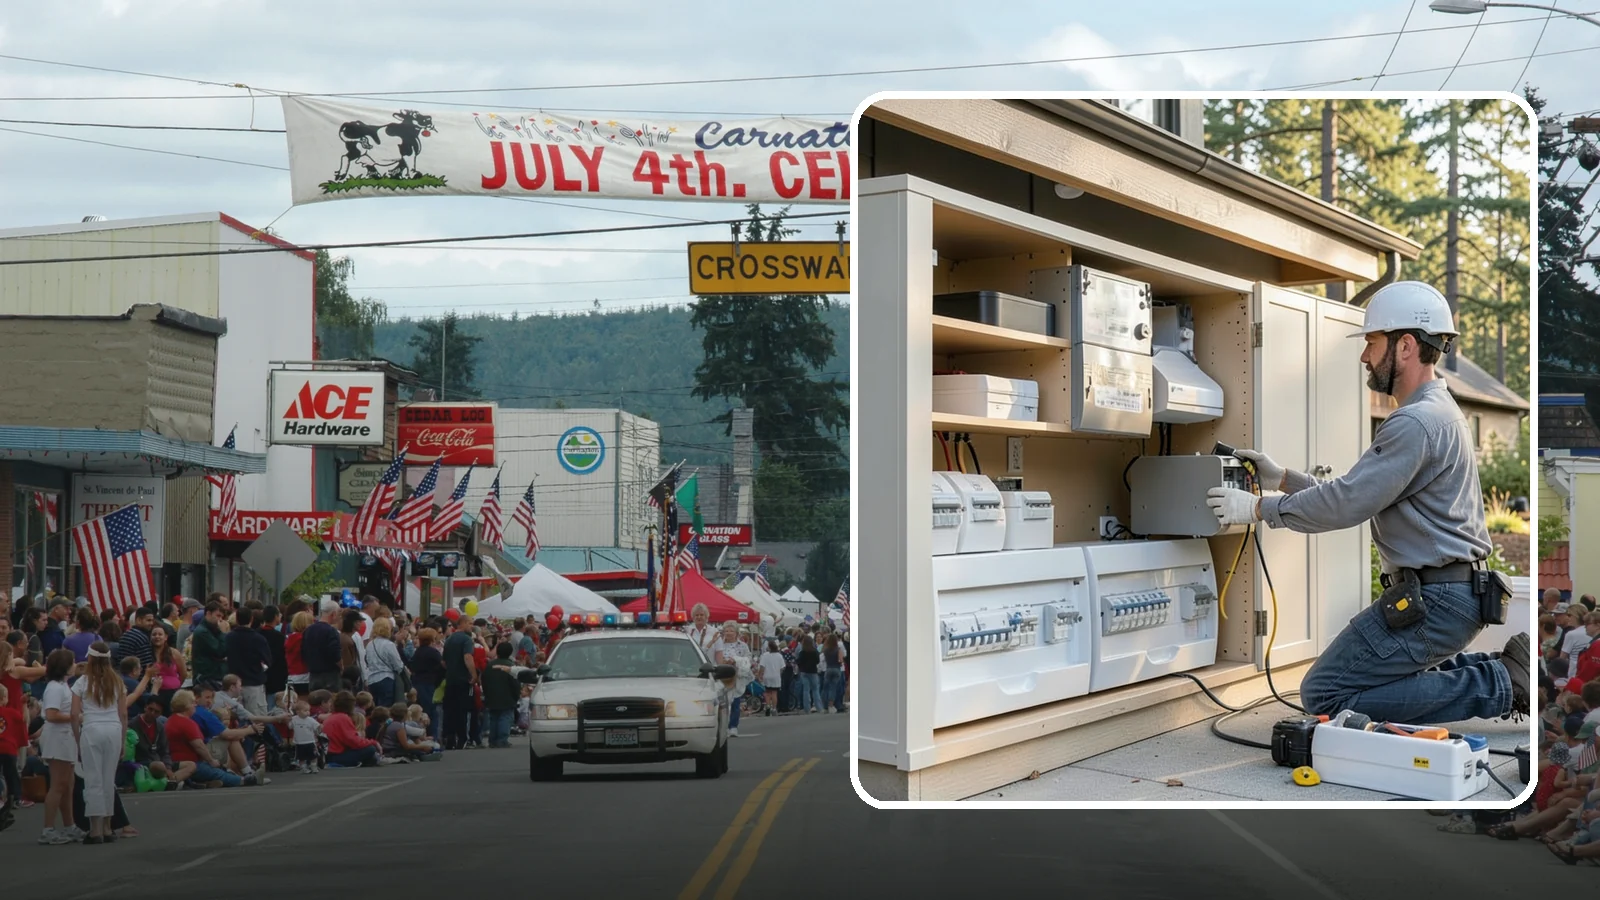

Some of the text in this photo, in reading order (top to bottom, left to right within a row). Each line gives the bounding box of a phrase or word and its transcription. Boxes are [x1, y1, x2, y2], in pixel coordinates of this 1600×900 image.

[481, 140, 604, 192] JULY
[632, 150, 746, 198] 4th.
[697, 254, 850, 280] CROSSWA
[283, 380, 374, 420] ACE
[405, 409, 452, 421] CEDAR
[283, 421, 371, 436] Hardware
[416, 428, 477, 447] Coca-Cola
[353, 467, 386, 479] Simpl
[83, 485, 155, 495] St. Vincent de Paul
[688, 526, 741, 535] CRNATION
[699, 535, 730, 543] GLASS
